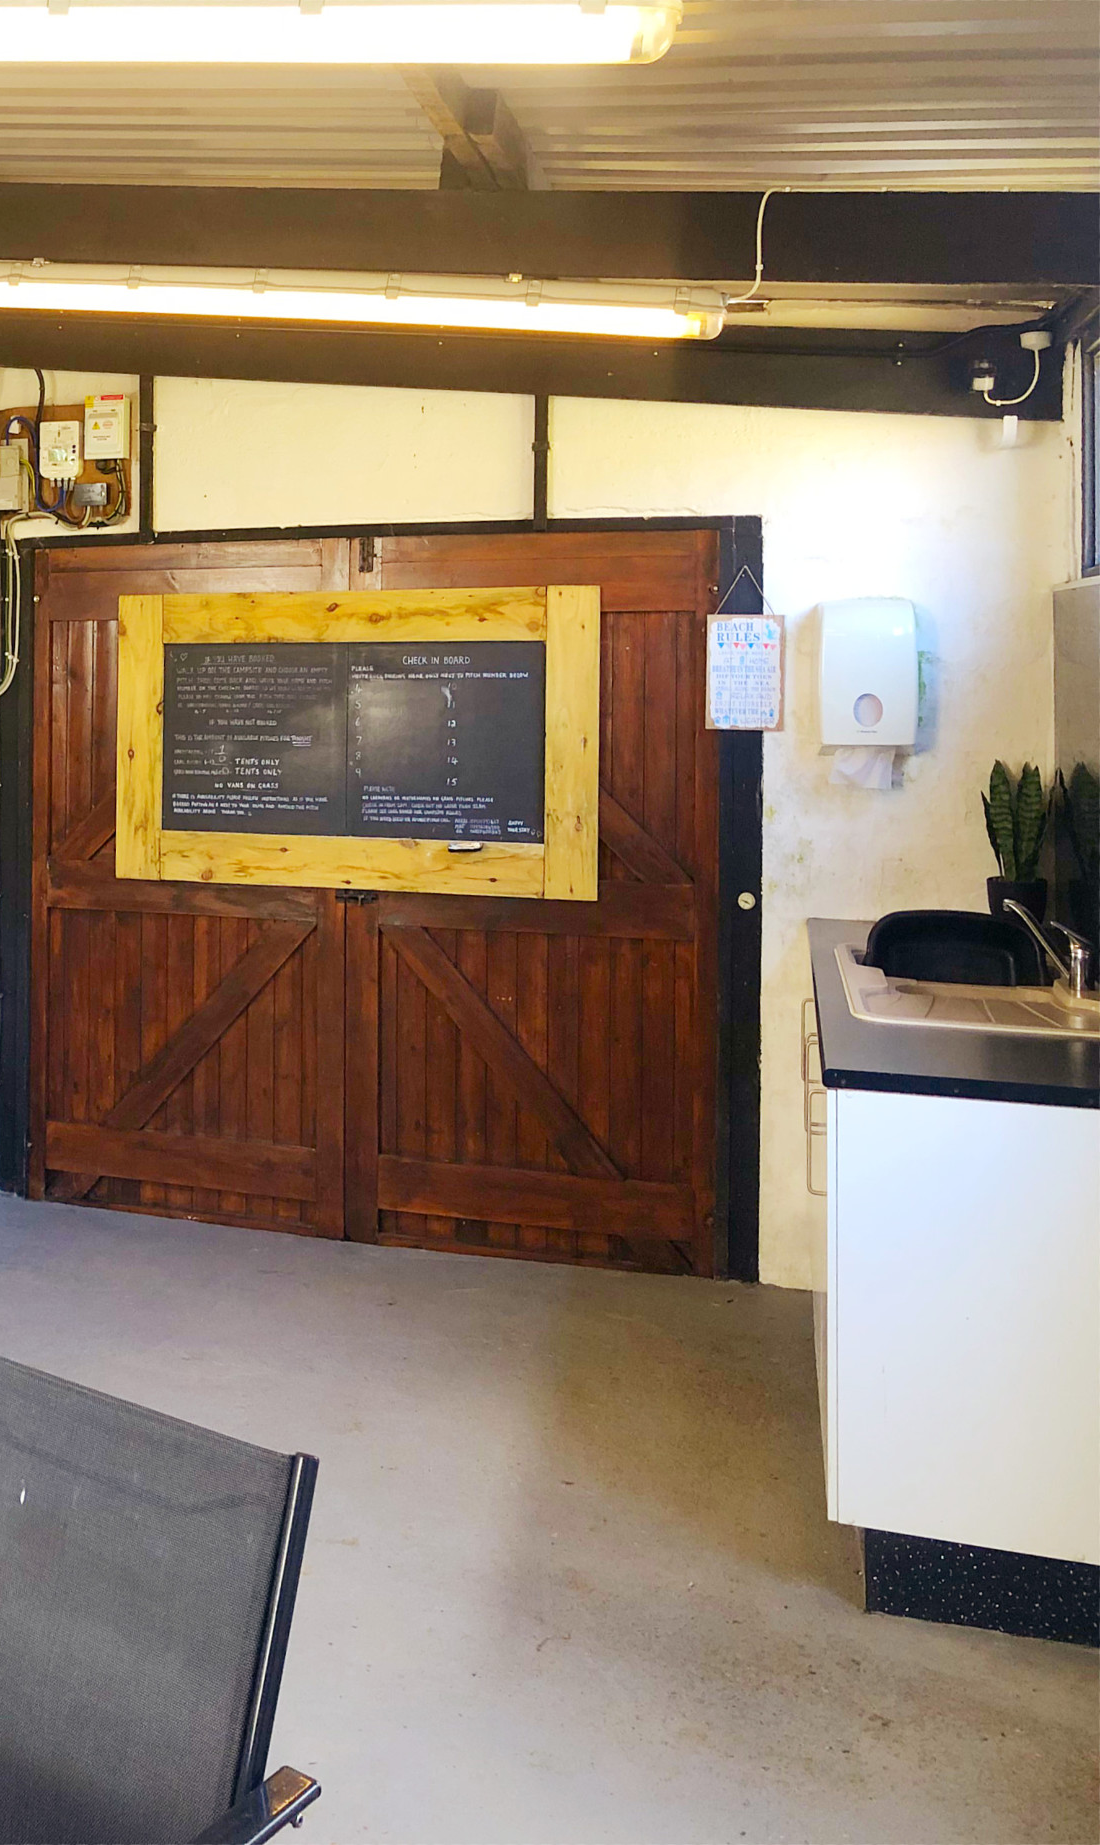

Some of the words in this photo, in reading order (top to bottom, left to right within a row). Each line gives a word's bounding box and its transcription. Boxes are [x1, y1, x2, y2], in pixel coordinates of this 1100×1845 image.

[716, 622, 754, 631] BEACH
[717, 632, 761, 641] RULES
[402, 656, 428, 665] CHECK
[431, 656, 440, 665] IN
[443, 656, 471, 665] BOARD
[354, 700, 362, 710] 5
[447, 719, 457, 728] 12
[356, 735, 363, 745] 7
[447, 738, 457, 746] 13
[235, 757, 259, 766] TENTS
[261, 758, 280, 766] ONLY
[447, 757, 459, 765] 14
[235, 767, 260, 776] TENTS
[263, 768, 283, 776] ONLY
[355, 767, 362, 778] 9
[446, 777, 458, 786] 15
